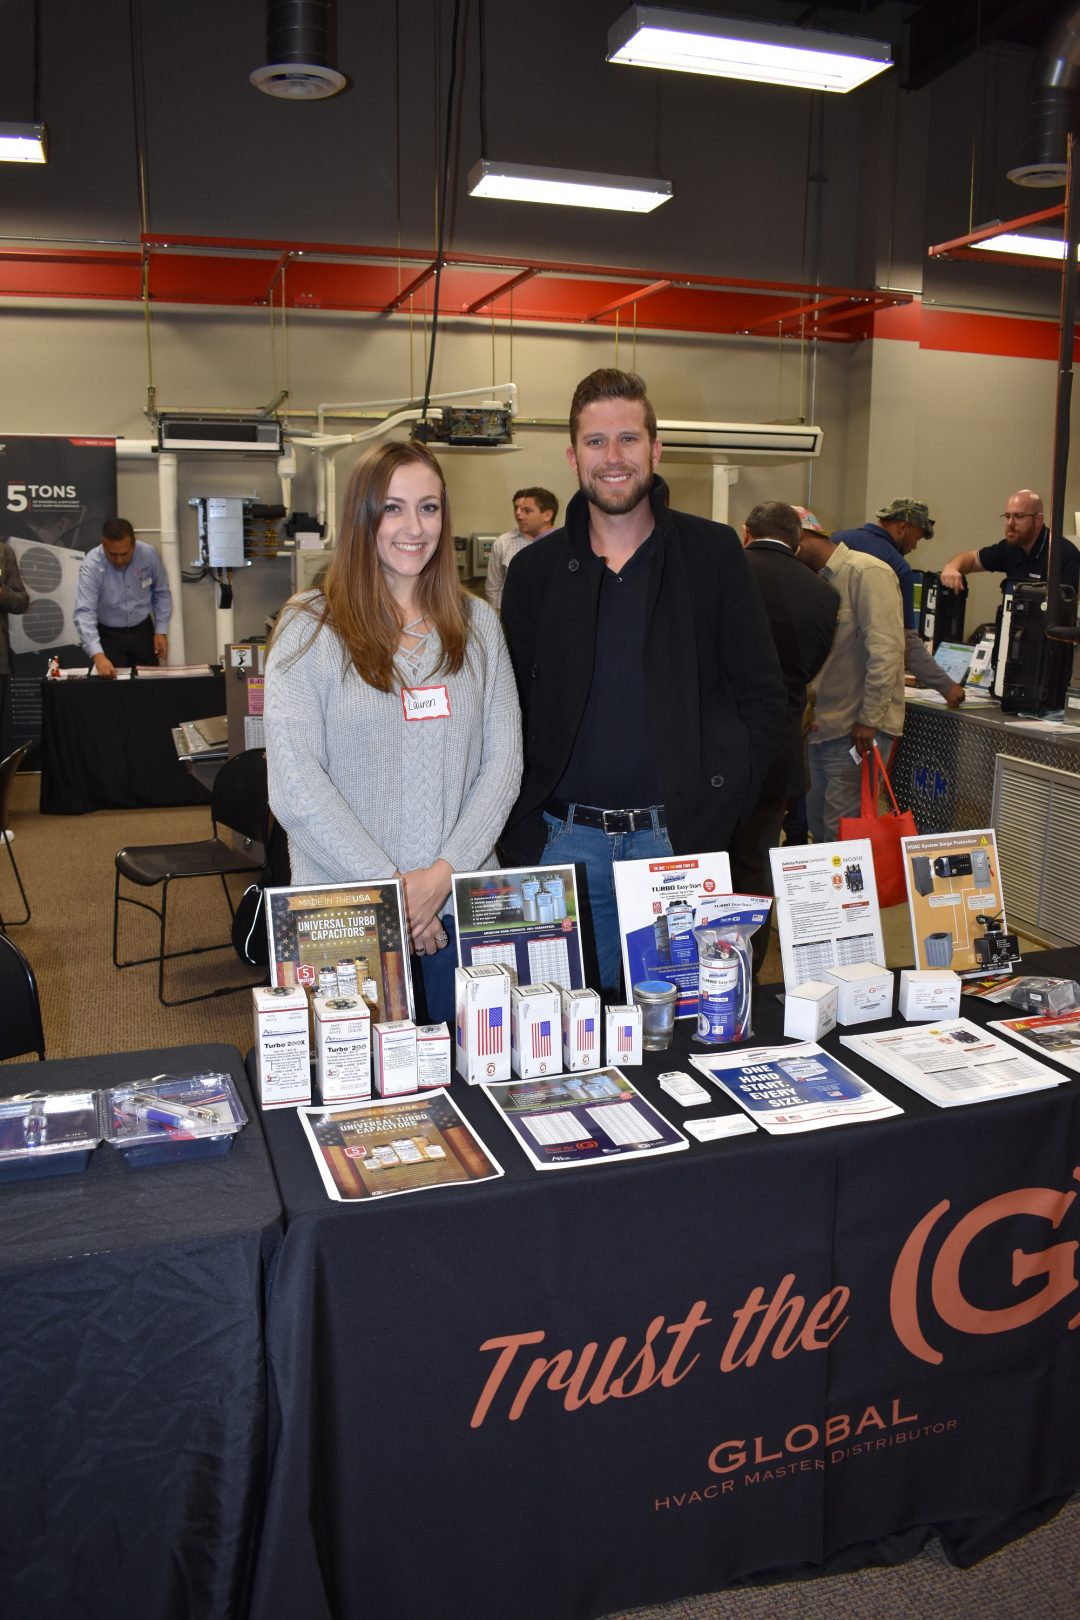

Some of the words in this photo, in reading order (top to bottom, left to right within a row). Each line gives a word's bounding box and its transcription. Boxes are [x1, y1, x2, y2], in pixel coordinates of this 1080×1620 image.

[6, 484, 28, 512] 5
[28, 485, 76, 498] TONS
[408, 698, 436, 711] Lauren
[298, 897, 323, 906] MADE
[324, 897, 333, 905] IN
[335, 895, 352, 903] THE
[352, 894, 371, 902] USA
[298, 918, 345, 932] UNIVERSAL
[347, 915, 376, 926] TURBO
[311, 927, 365, 941] CAPACITORS
[264, 1041, 286, 1049] Turbo
[741, 1064, 773, 1074] ONE
[740, 1072, 780, 1085] HARD
[739, 1081, 790, 1093] START.
[748, 1087, 796, 1101] EVERY
[768, 1097, 808, 1108] SIZE.
[340, 1118, 394, 1132] UNIVERSAL
[396, 1113, 428, 1123] TURBO
[356, 1121, 418, 1135] CAPACITORS
[470, 1300, 713, 1430] Trust
[719, 1273, 851, 1373] the
[707, 1398, 919, 1474] GLOBAL
[654, 1479, 735, 1512] HVACR
[744, 1457, 826, 1486] MASTER
[831, 1418, 958, 1465] DISTRIBUTOR
